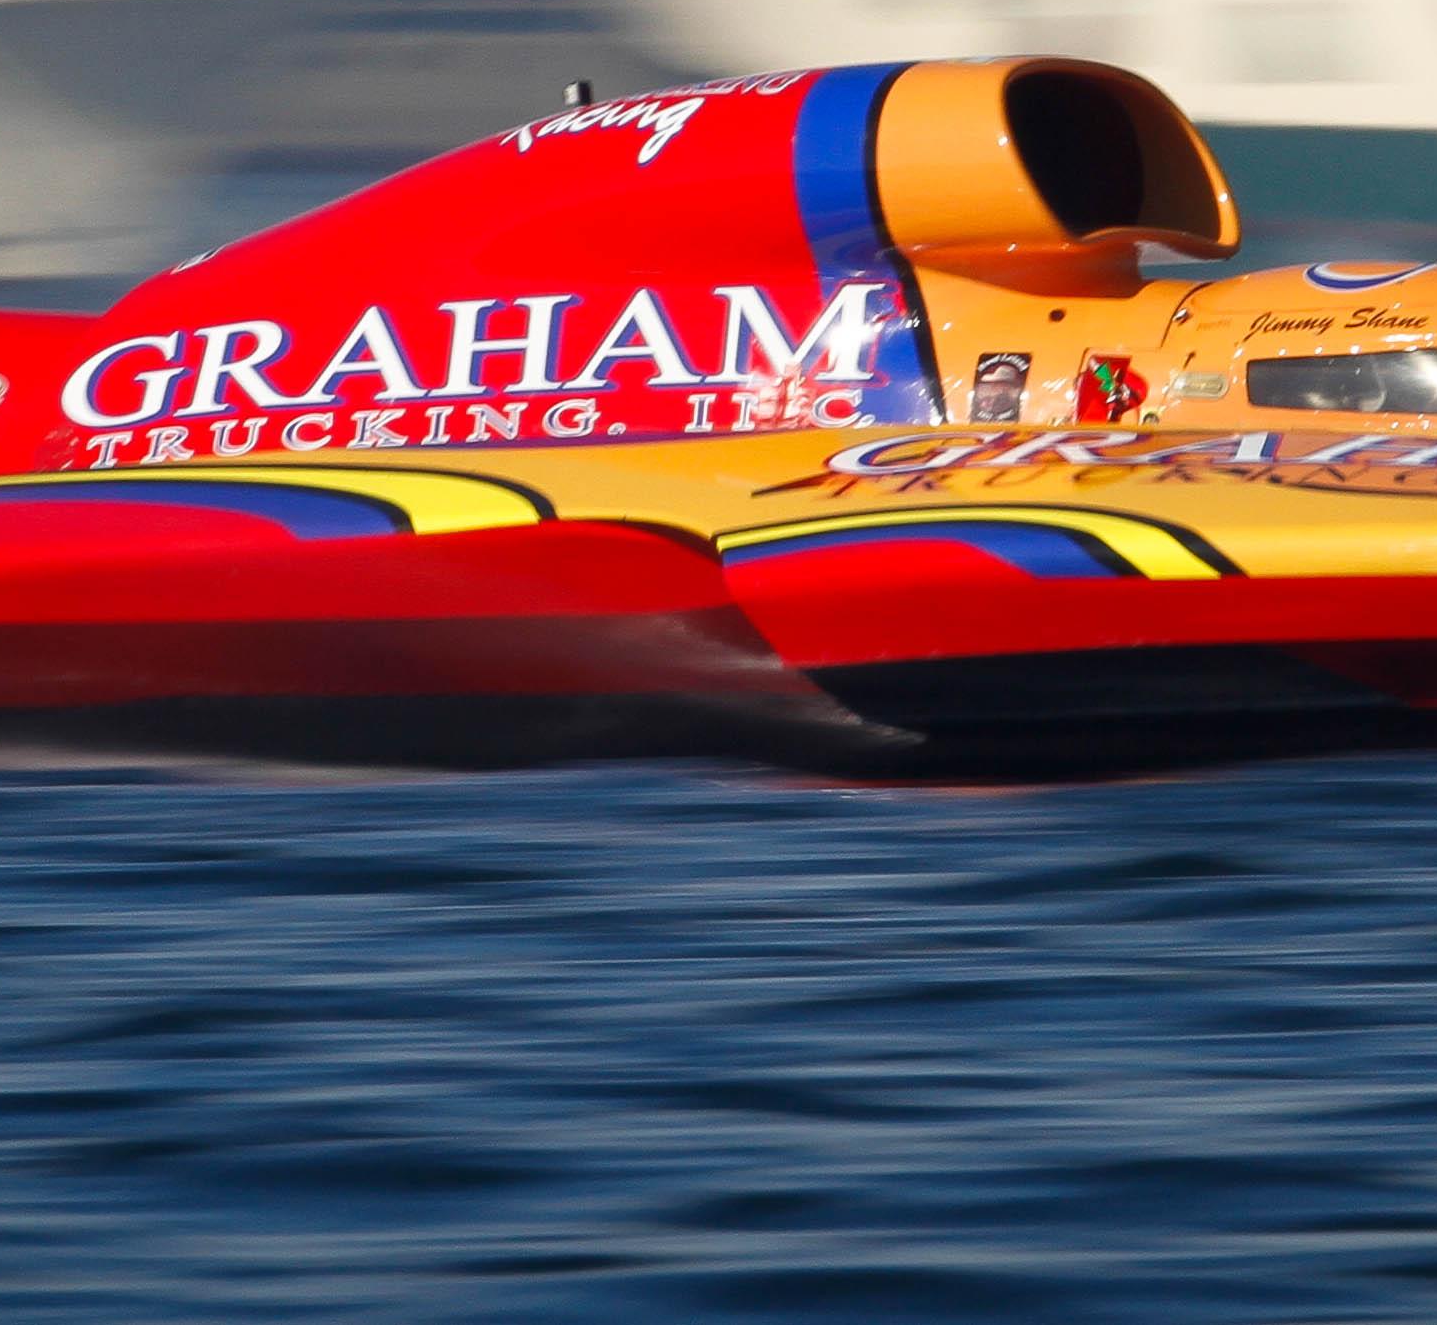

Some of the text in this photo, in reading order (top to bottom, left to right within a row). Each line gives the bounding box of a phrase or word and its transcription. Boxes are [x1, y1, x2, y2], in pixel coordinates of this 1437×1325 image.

[60, 281, 890, 430] GRAHAM
[1242, 311, 1335, 343] Jimmy
[1344, 306, 1430, 330] Shane
